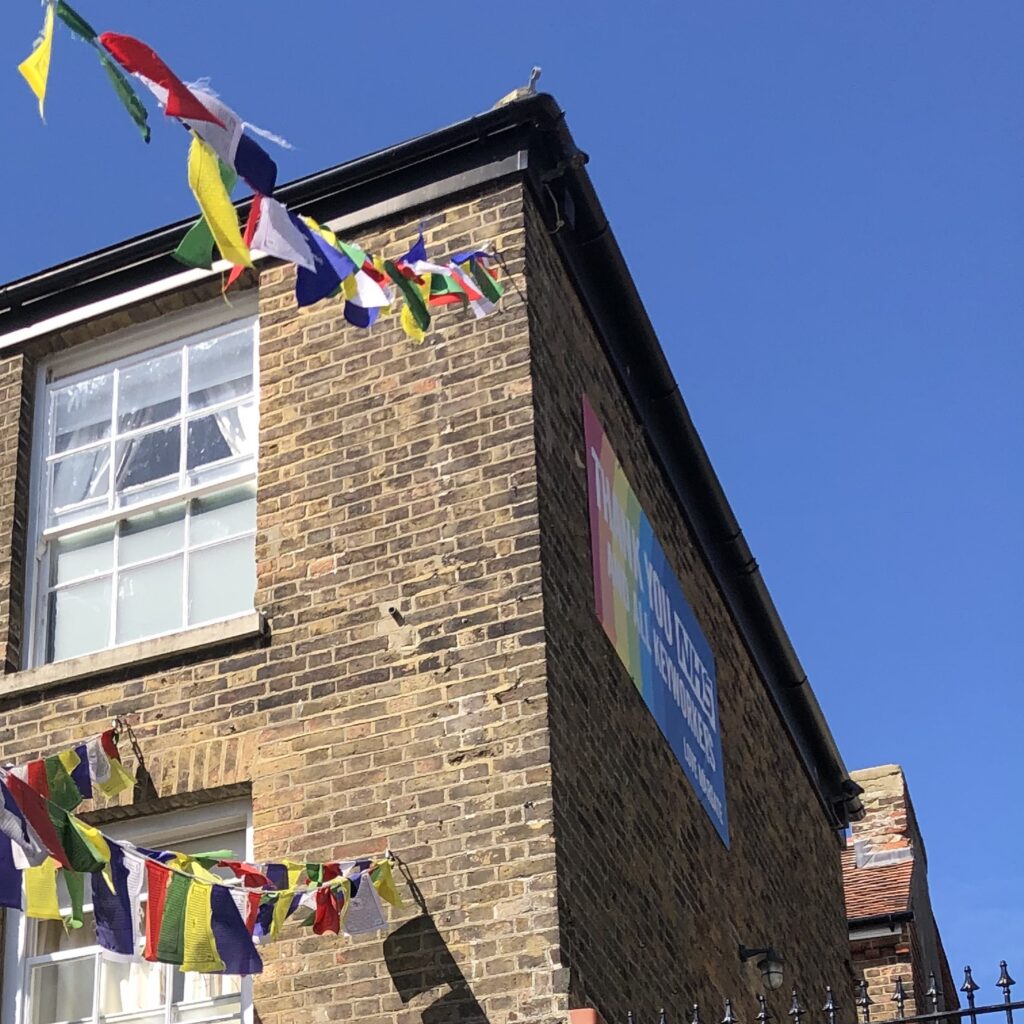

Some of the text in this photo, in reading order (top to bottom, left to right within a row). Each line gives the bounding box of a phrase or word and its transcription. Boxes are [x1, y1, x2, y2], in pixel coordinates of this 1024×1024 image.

[591, 446, 716, 732] THANK YOU NHS
